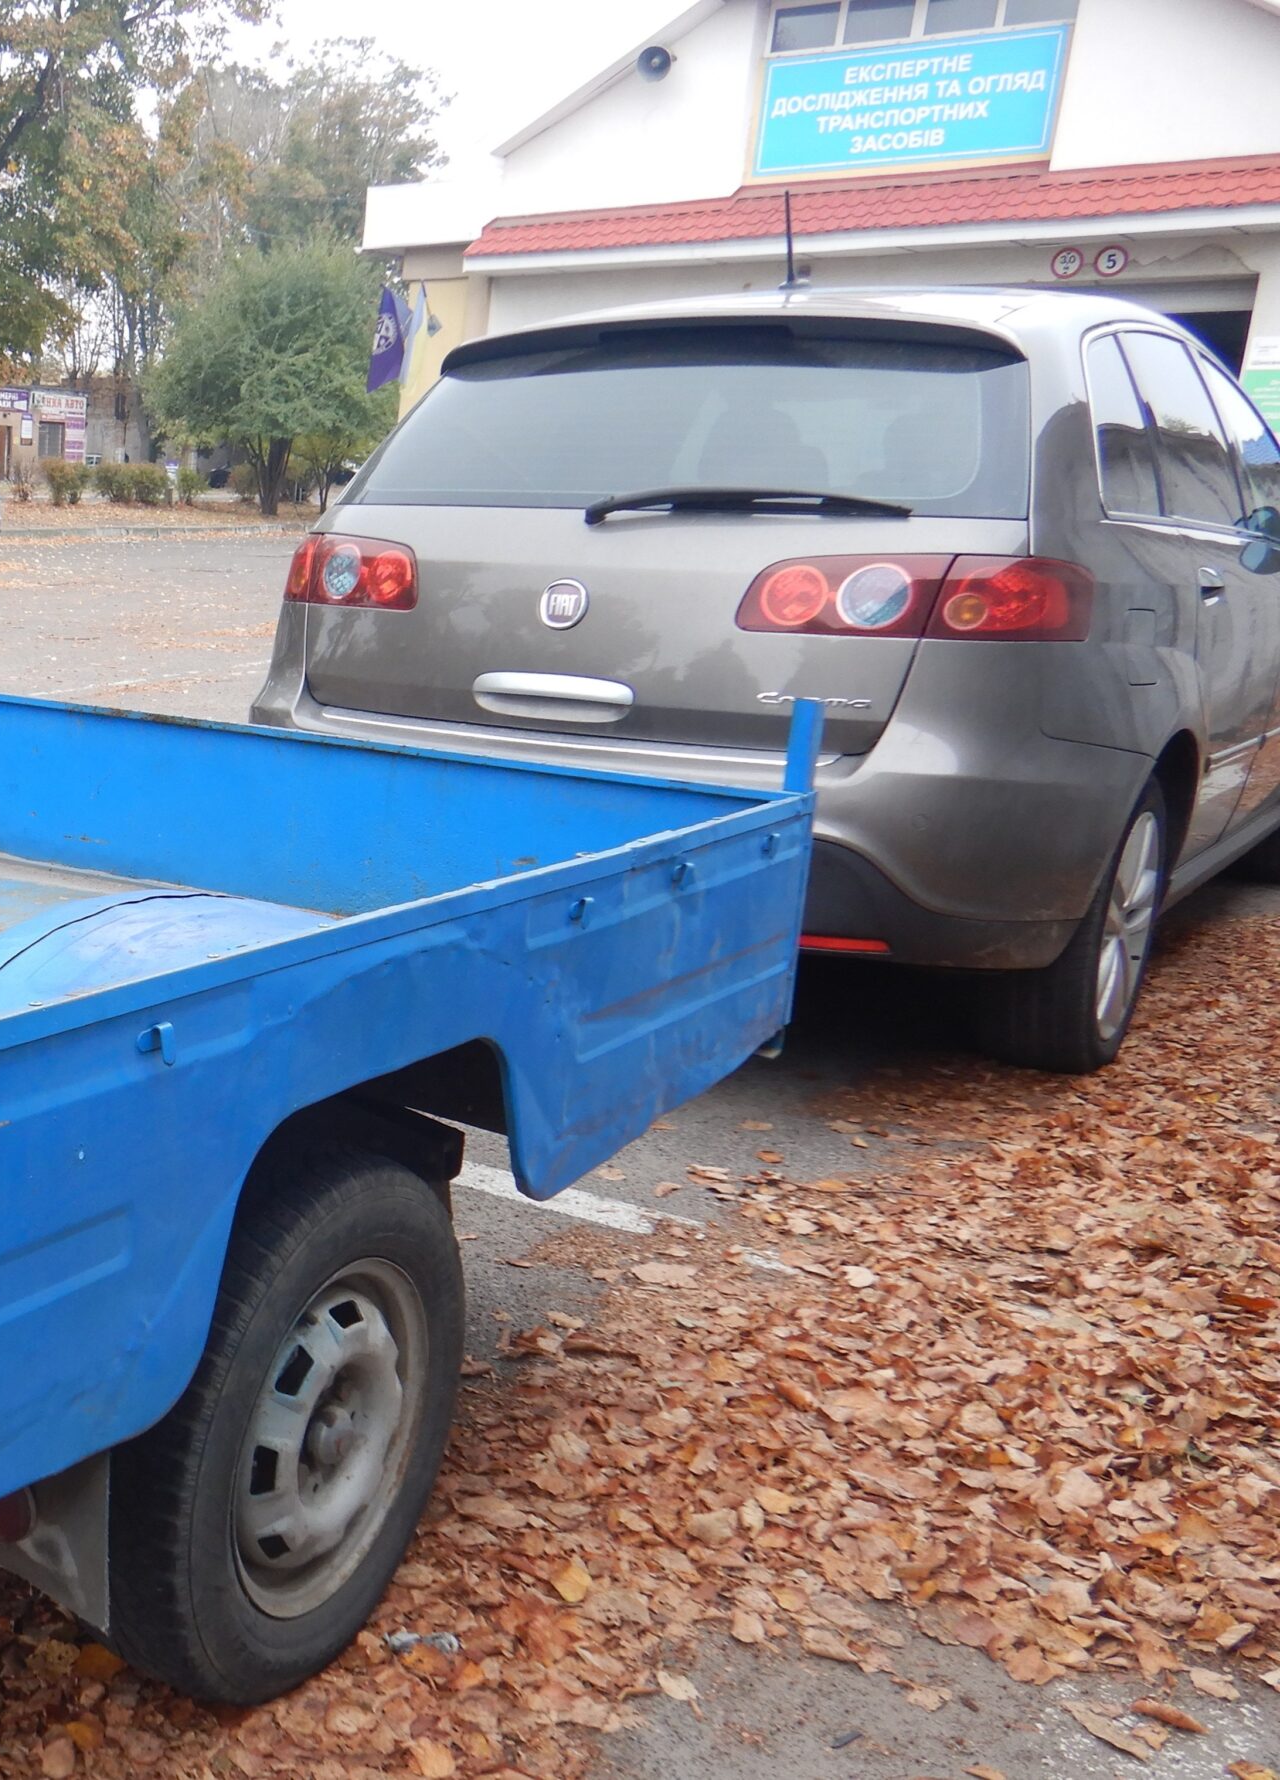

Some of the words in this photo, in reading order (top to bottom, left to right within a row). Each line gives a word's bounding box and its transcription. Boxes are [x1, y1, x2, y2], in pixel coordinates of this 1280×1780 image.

[844, 54, 973, 85] ЕКСПЕРТНЕ
[771, 83, 929, 118] ДОСЛІДЖЕННЯ
[935, 80, 962, 98] ТА
[968, 70, 1047, 96] ОГЛЯД
[816, 100, 991, 134] ТРАНСПОРТНИХ
[849, 129, 945, 154] ЗАСОБІВ
[1106, 253, 1117, 269] 5
[549, 594, 579, 616] FIAT
